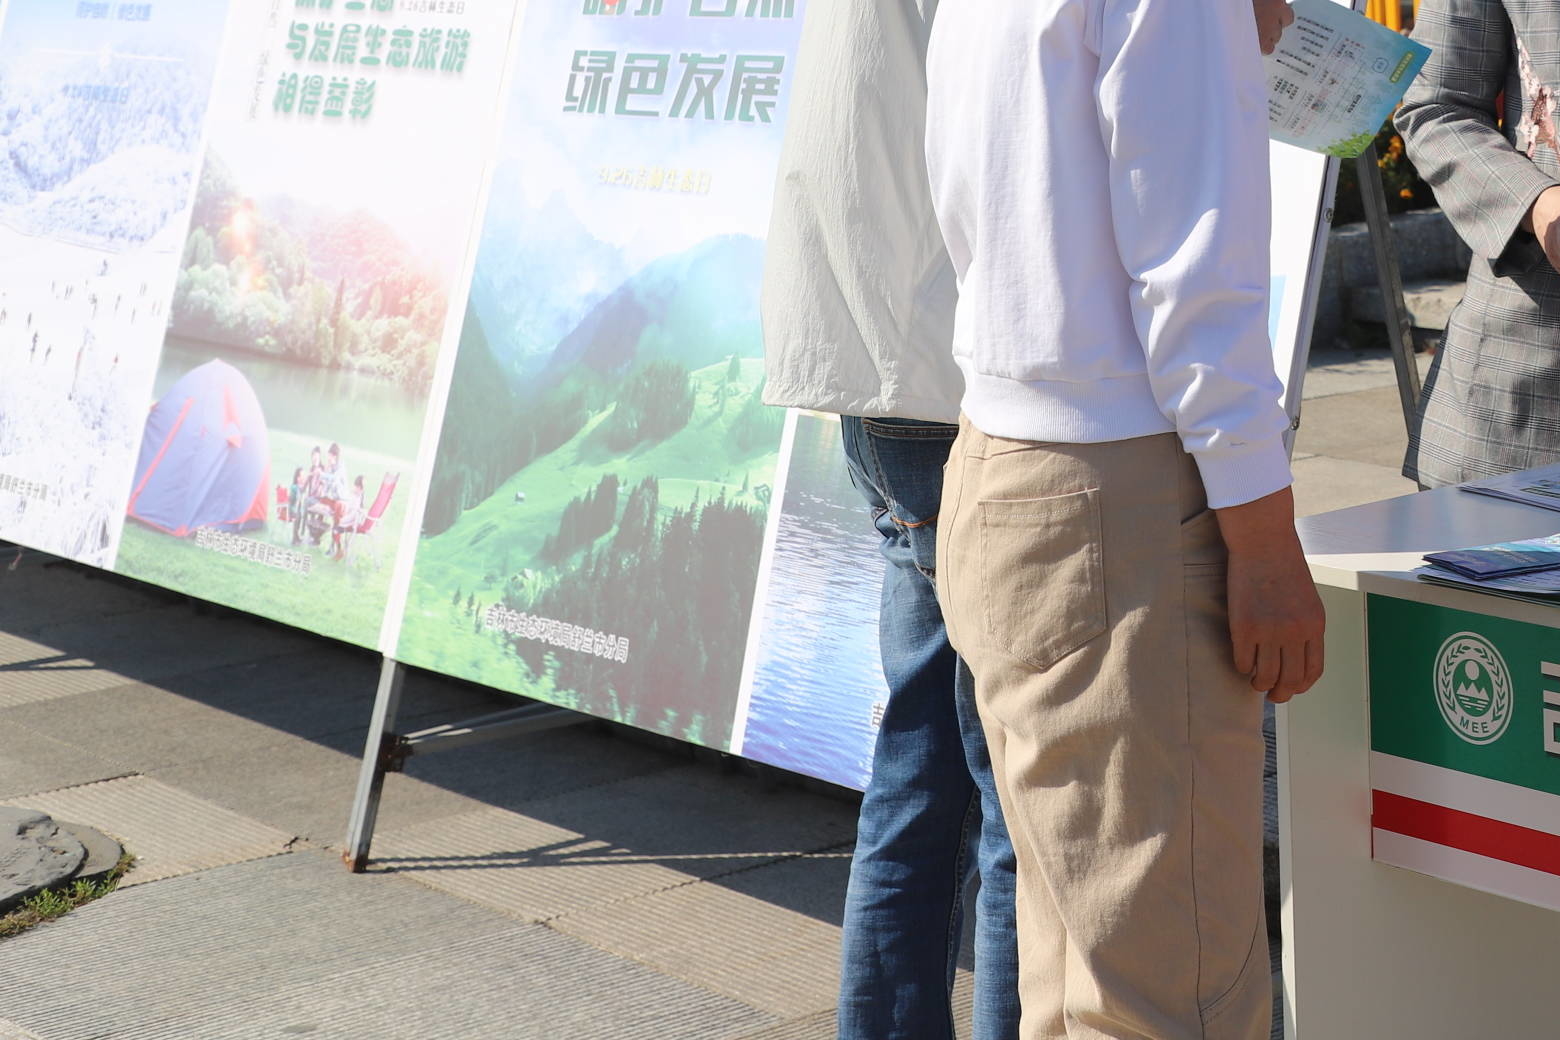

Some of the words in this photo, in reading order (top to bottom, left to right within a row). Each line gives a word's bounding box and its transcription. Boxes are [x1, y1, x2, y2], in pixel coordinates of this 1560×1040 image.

[286, 20, 471, 74] 与发展生态旅游
[562, 49, 786, 124] 绿色发展
[1459, 716, 1490, 734] MEE
